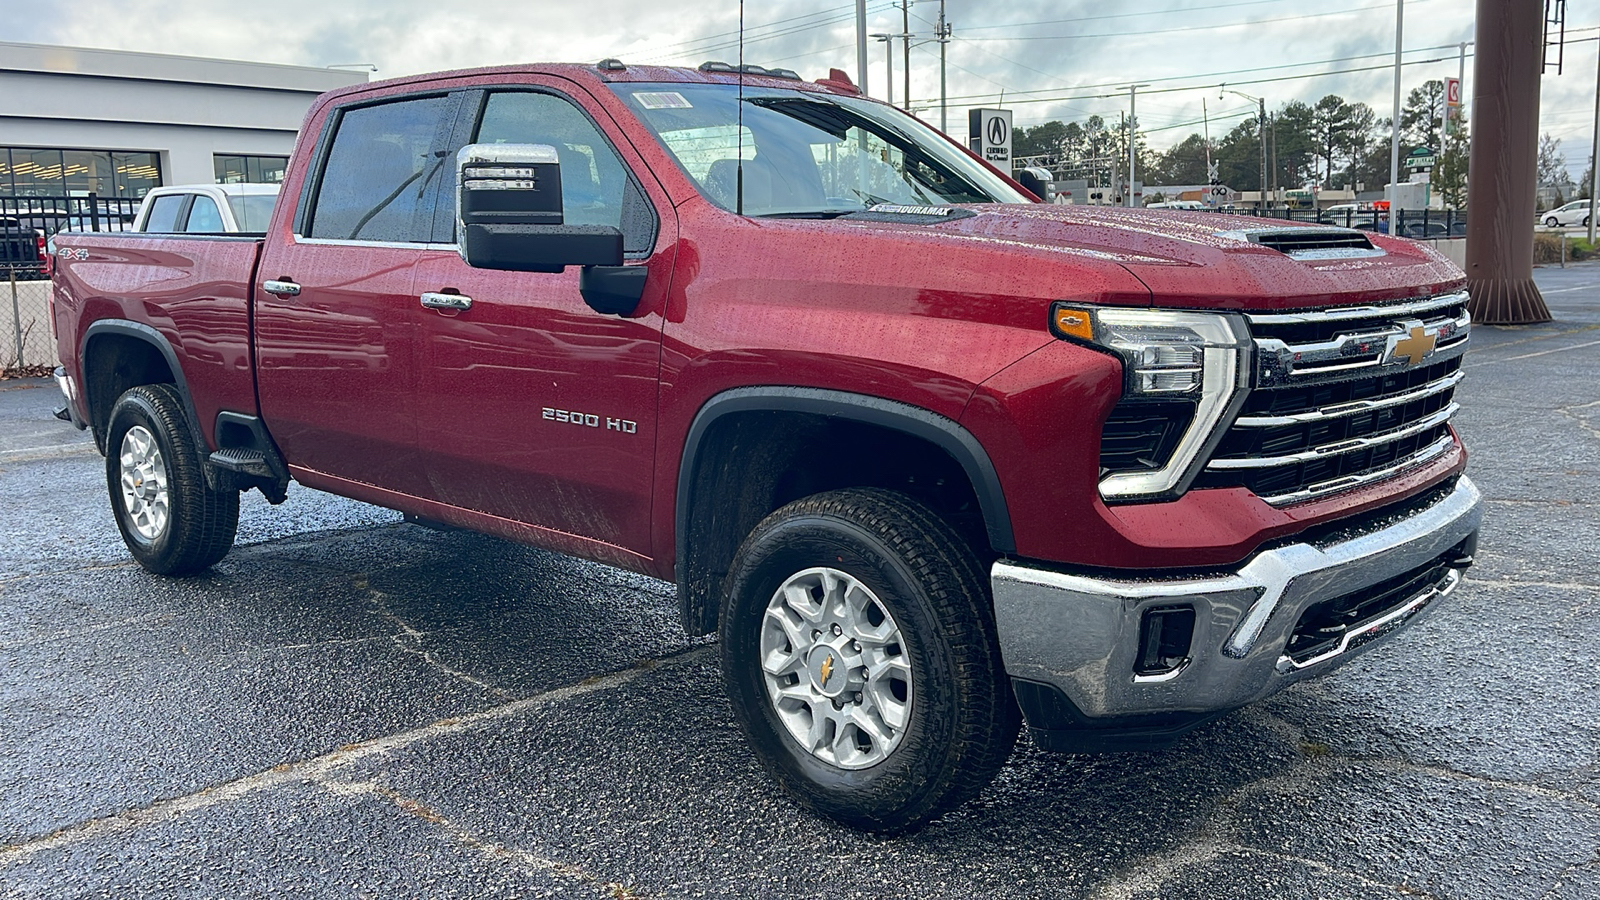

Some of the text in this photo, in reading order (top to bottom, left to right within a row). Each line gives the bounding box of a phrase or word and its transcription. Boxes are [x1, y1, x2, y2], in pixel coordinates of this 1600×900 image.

[899, 205, 952, 216] DURAMAX
[542, 406, 637, 434] 2500 HD
